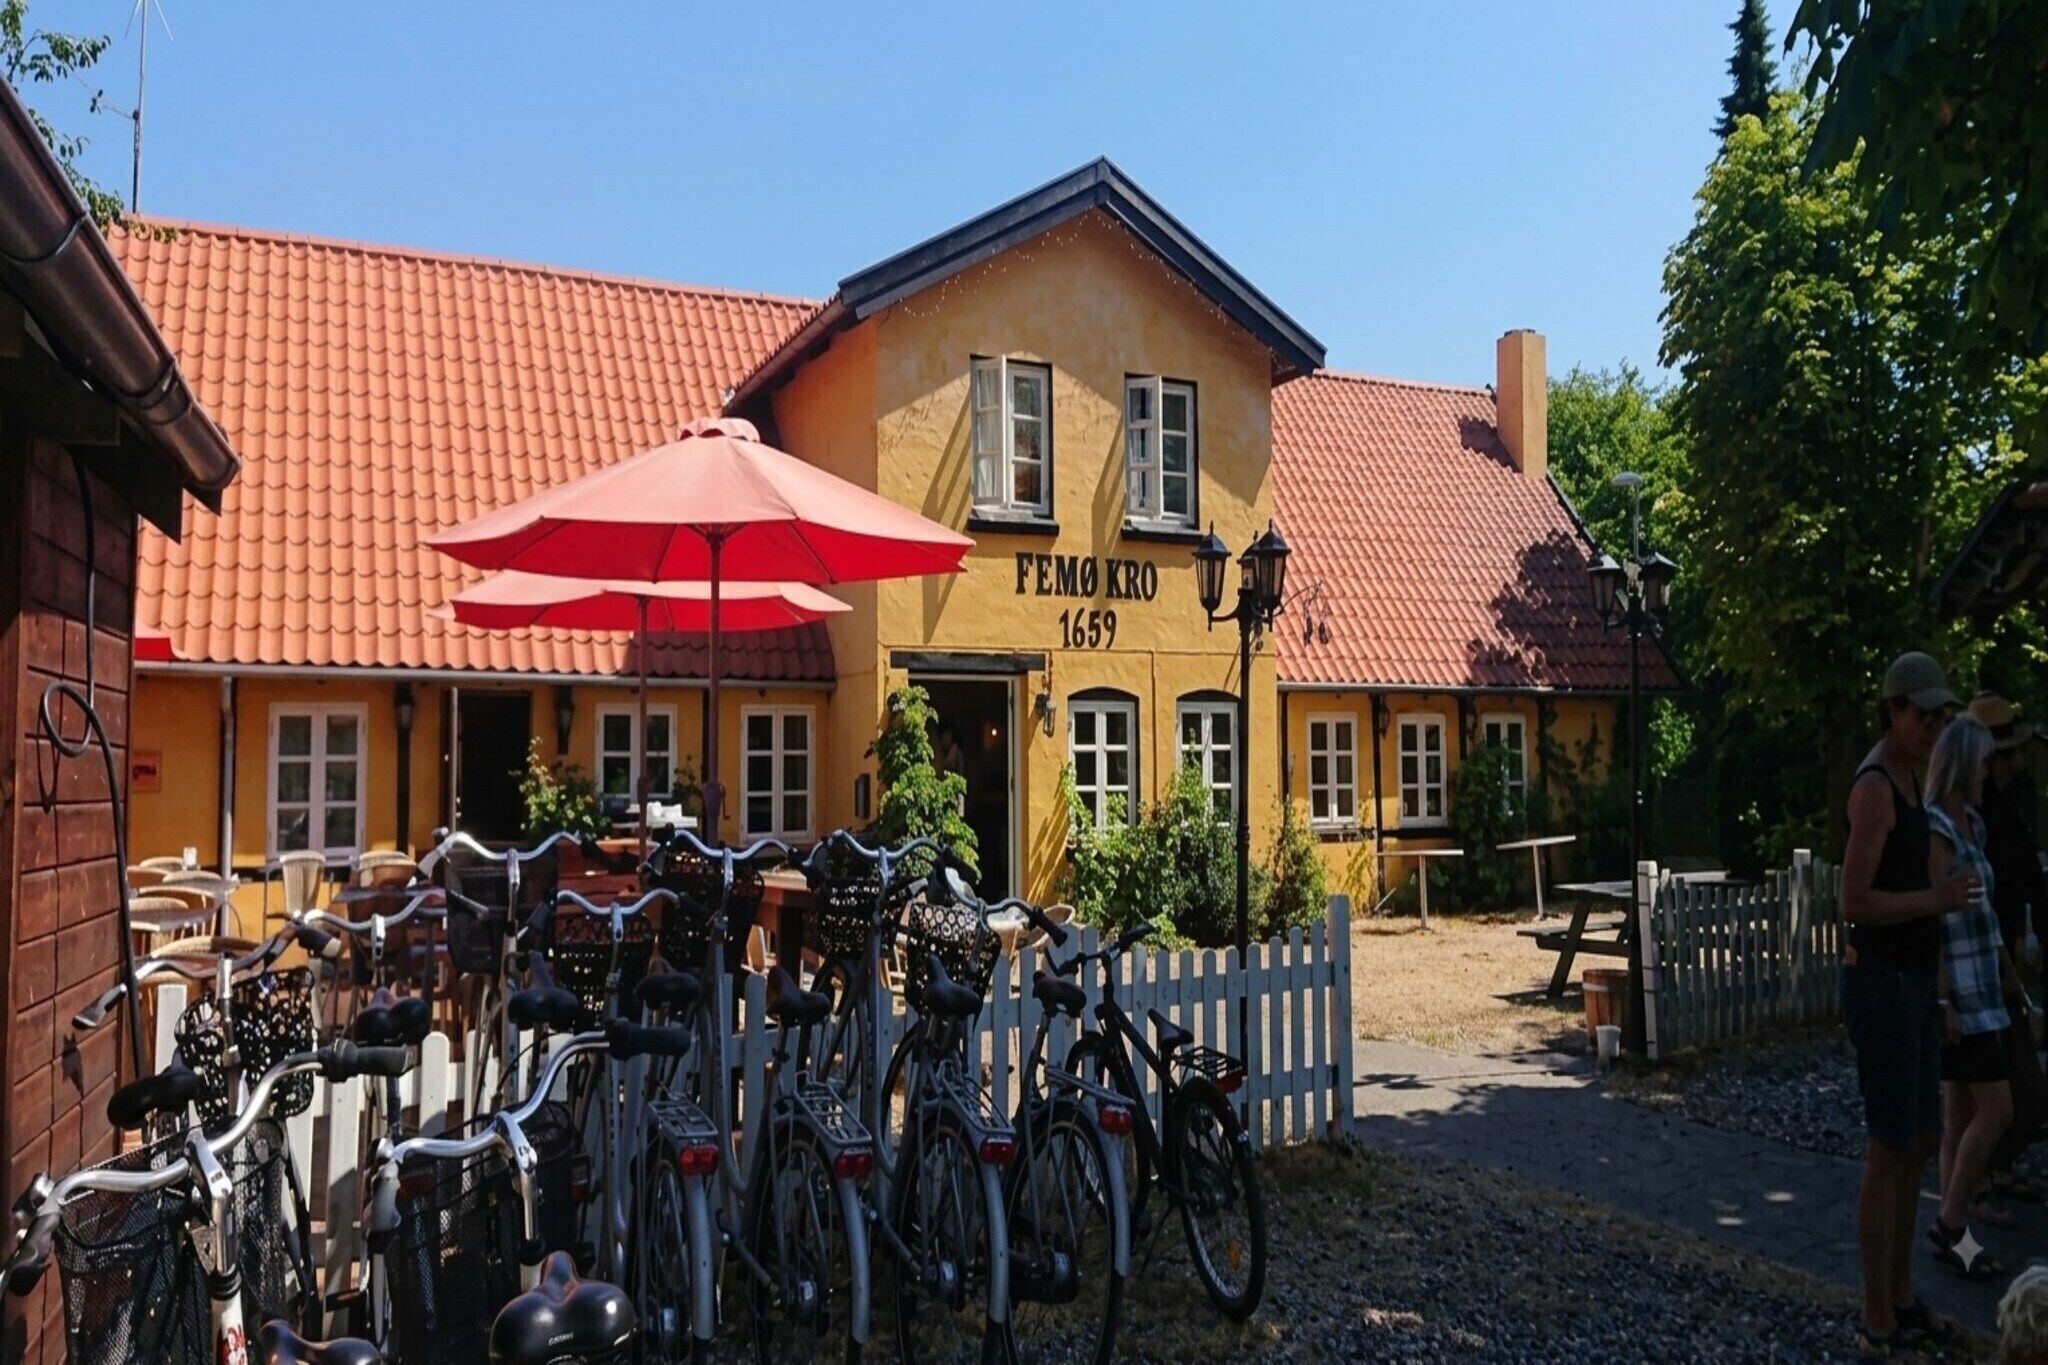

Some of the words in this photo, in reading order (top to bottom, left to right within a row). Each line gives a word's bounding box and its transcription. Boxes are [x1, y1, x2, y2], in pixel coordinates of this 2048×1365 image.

[1015, 552, 1098, 598] FEMØ
[1105, 558, 1158, 602] KRO
[1059, 607, 1117, 649] 1659
